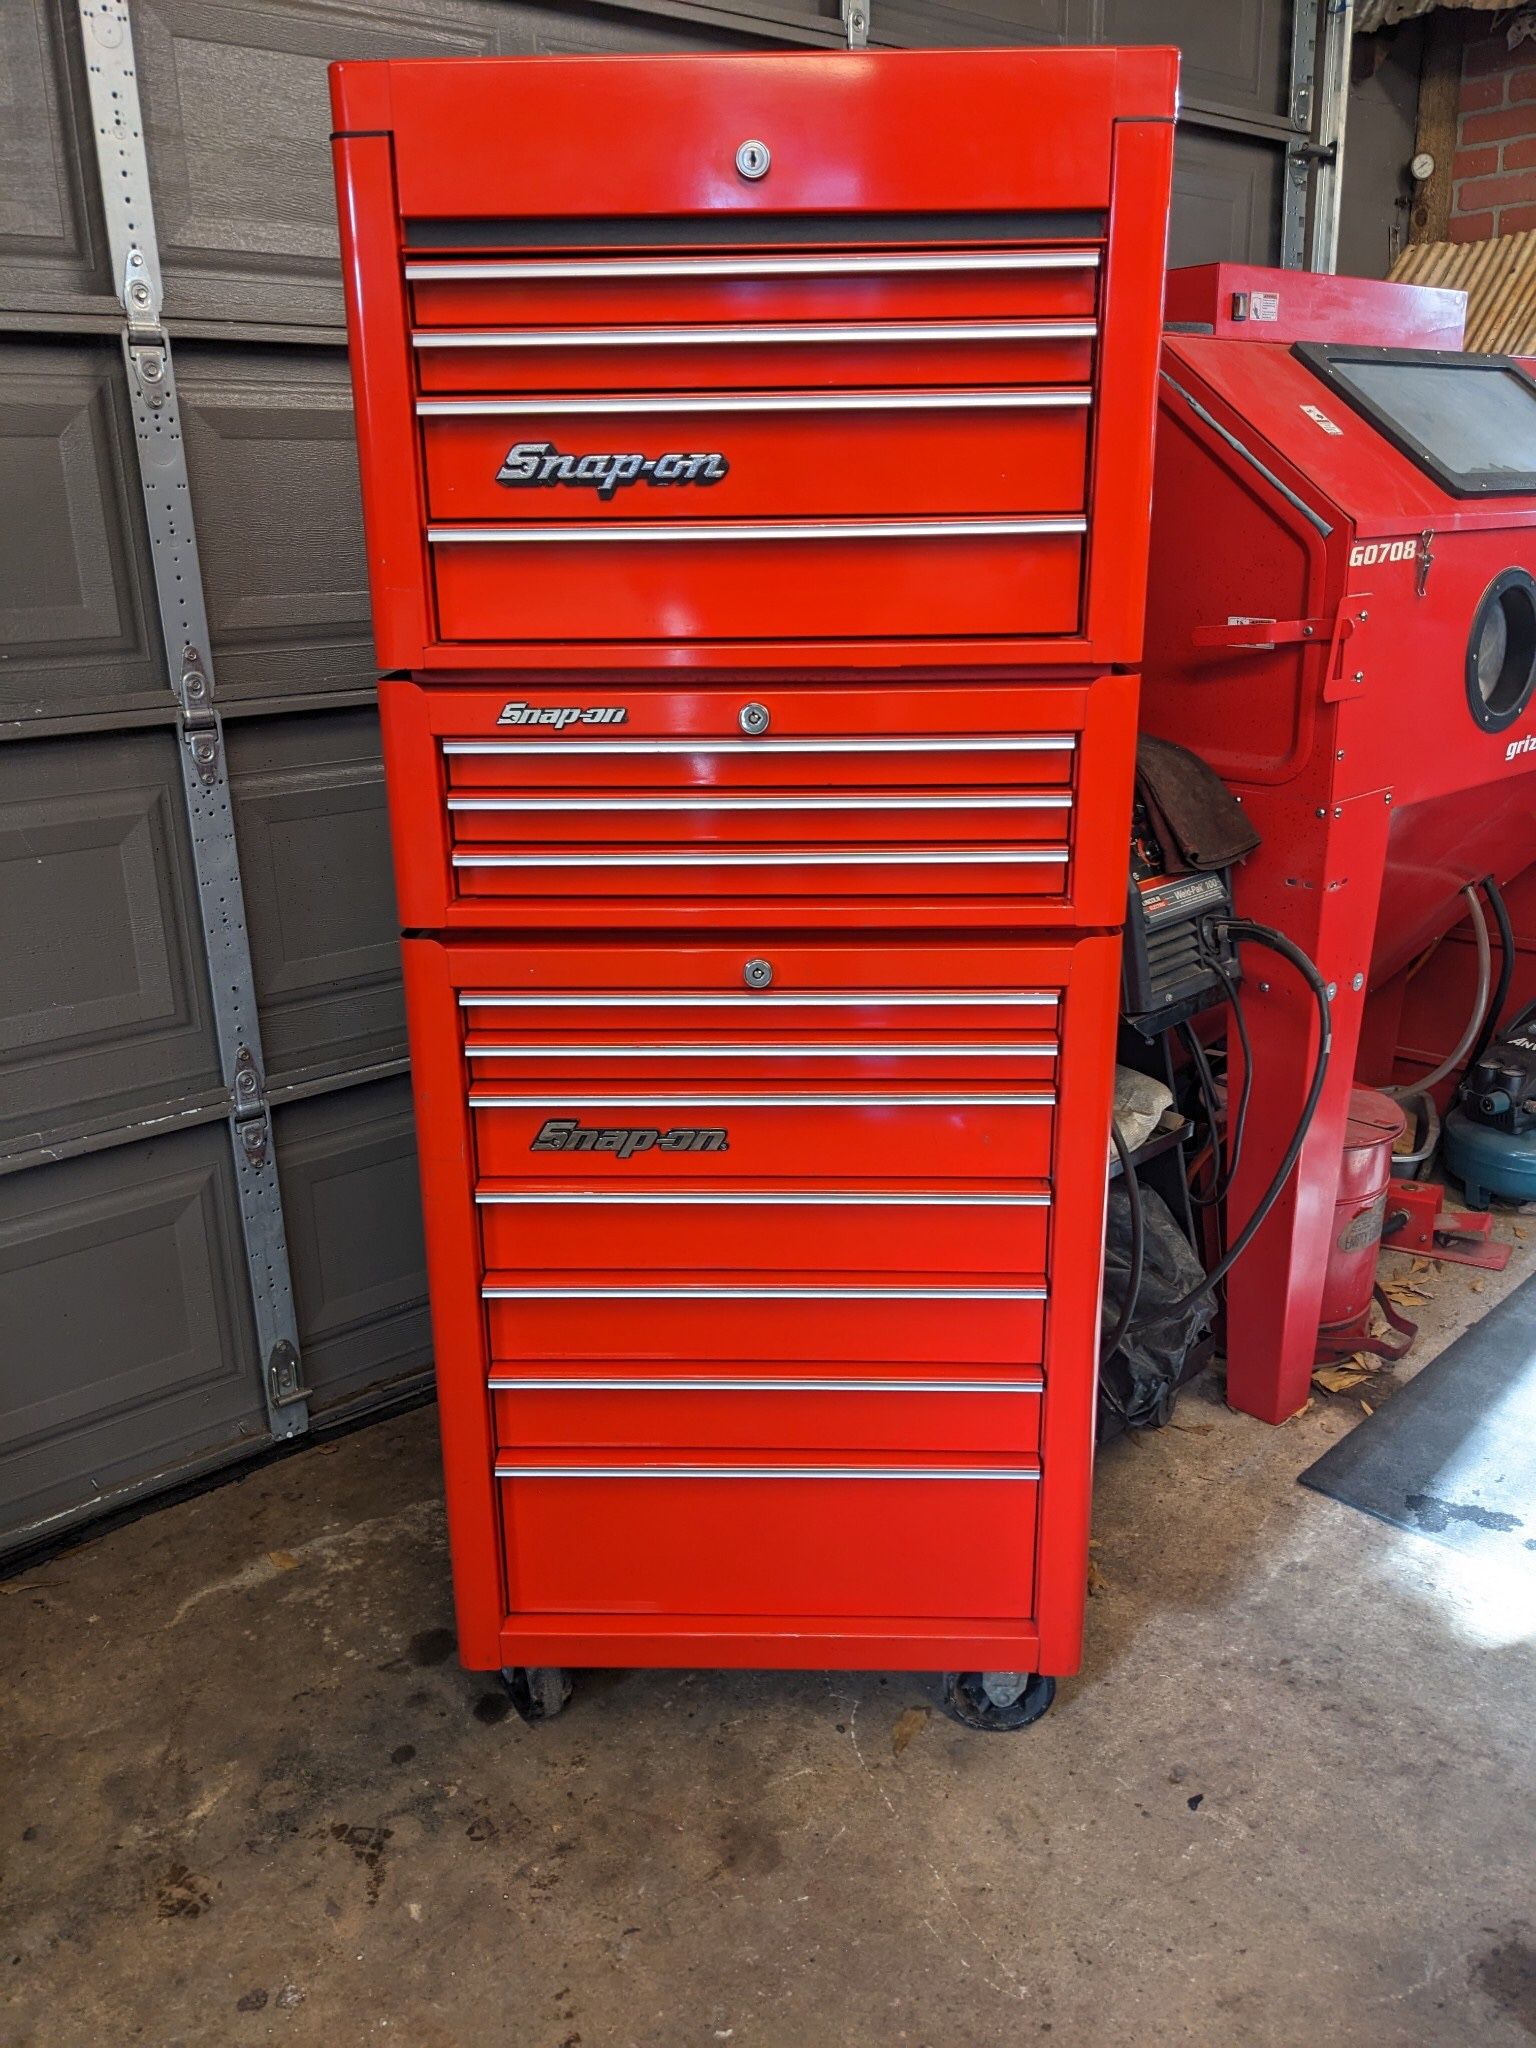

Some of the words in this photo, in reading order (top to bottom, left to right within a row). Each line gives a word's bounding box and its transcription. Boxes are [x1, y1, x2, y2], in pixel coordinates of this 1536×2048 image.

[496, 441, 729, 500] Snap-on
[1349, 540, 1417, 567] G0708
[496, 701, 628, 730] Snap-on
[1205, 879, 1218, 889] 100
[529, 1119, 728, 1159] Snap-on
